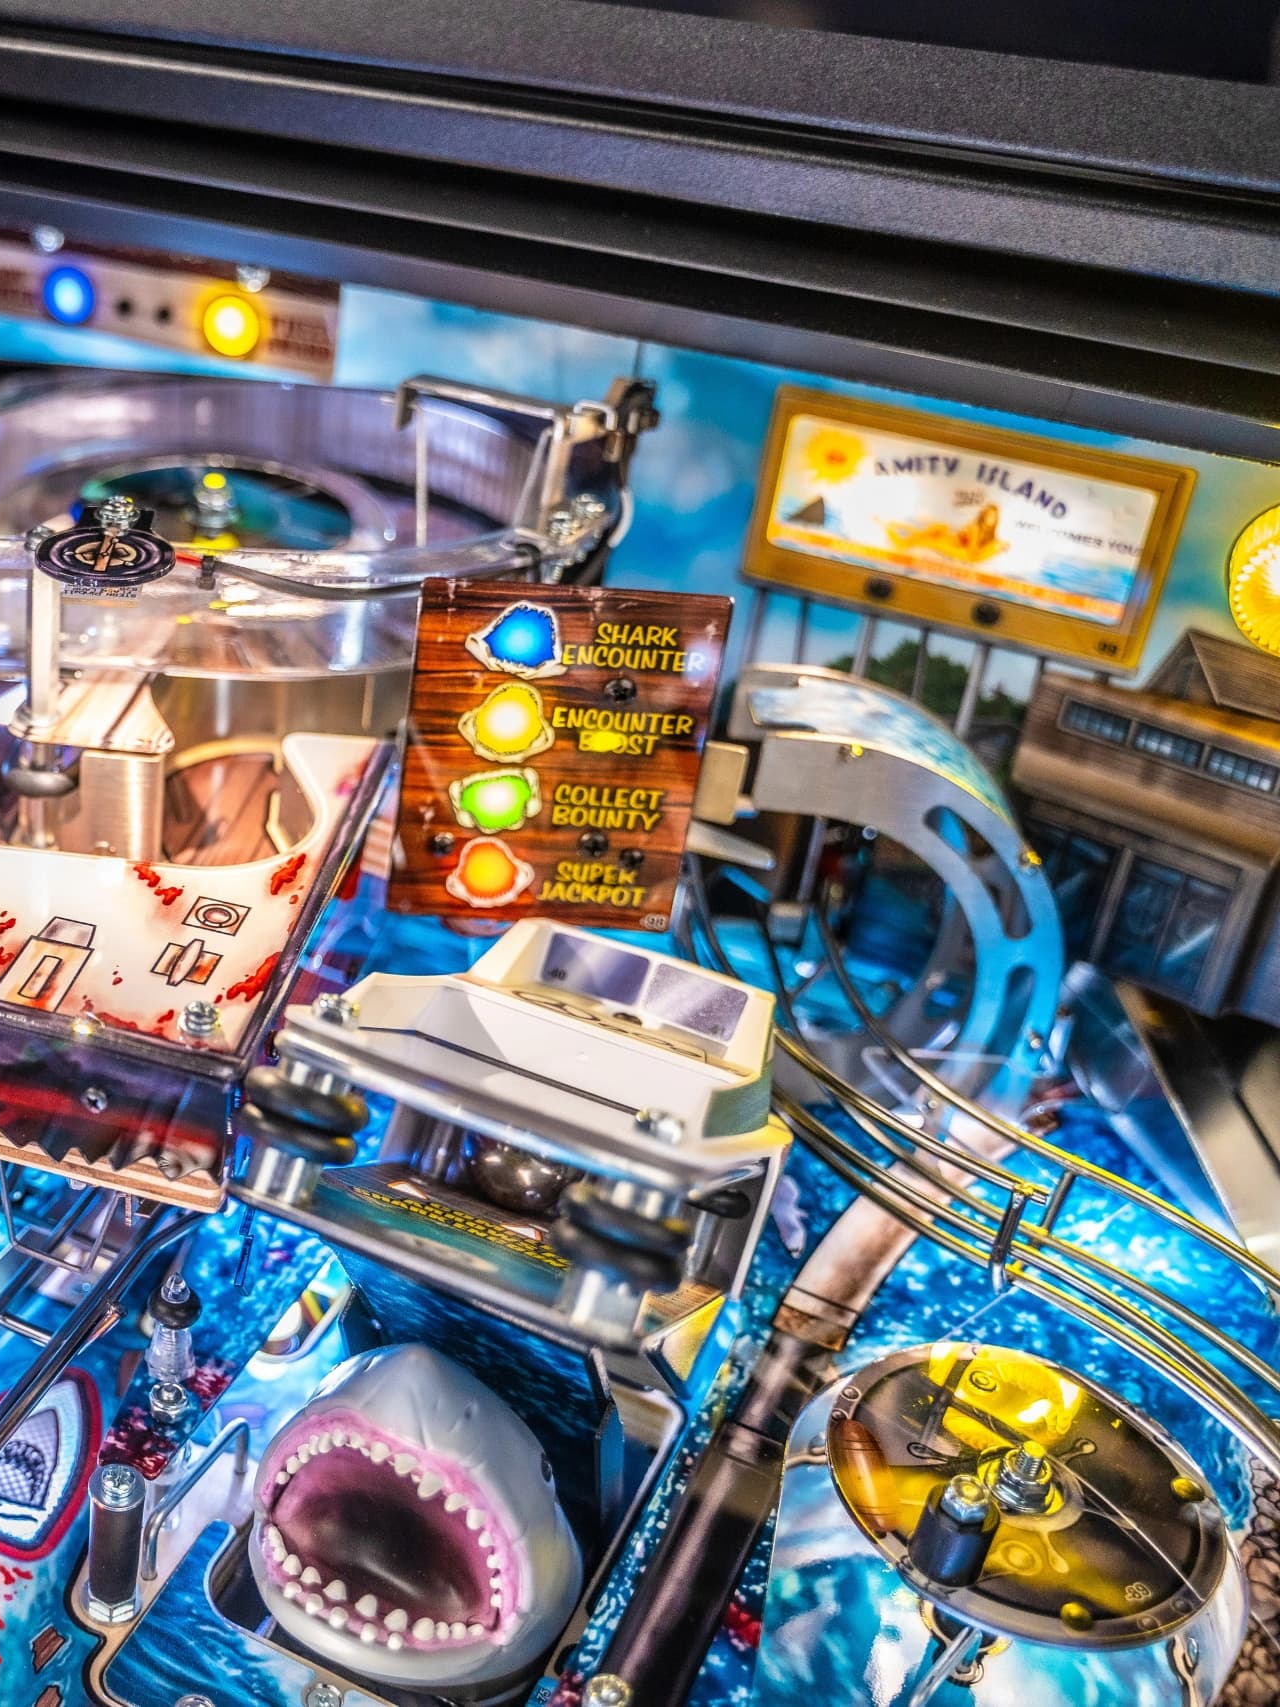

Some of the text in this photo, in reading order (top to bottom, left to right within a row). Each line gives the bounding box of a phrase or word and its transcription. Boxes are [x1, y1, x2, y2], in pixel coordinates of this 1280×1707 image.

[975, 463, 1068, 519] ISLAND
[595, 622, 678, 648] SHARK
[562, 644, 706, 673] ENCOUNTER
[552, 706, 694, 735] ENCOUNTER
[579, 731, 660, 756] BOST
[554, 784, 663, 811] COLLECT
[552, 806, 661, 832] BOUNTY
[555, 860, 637, 885] SUPER
[536, 881, 647, 908] JACKPOT
